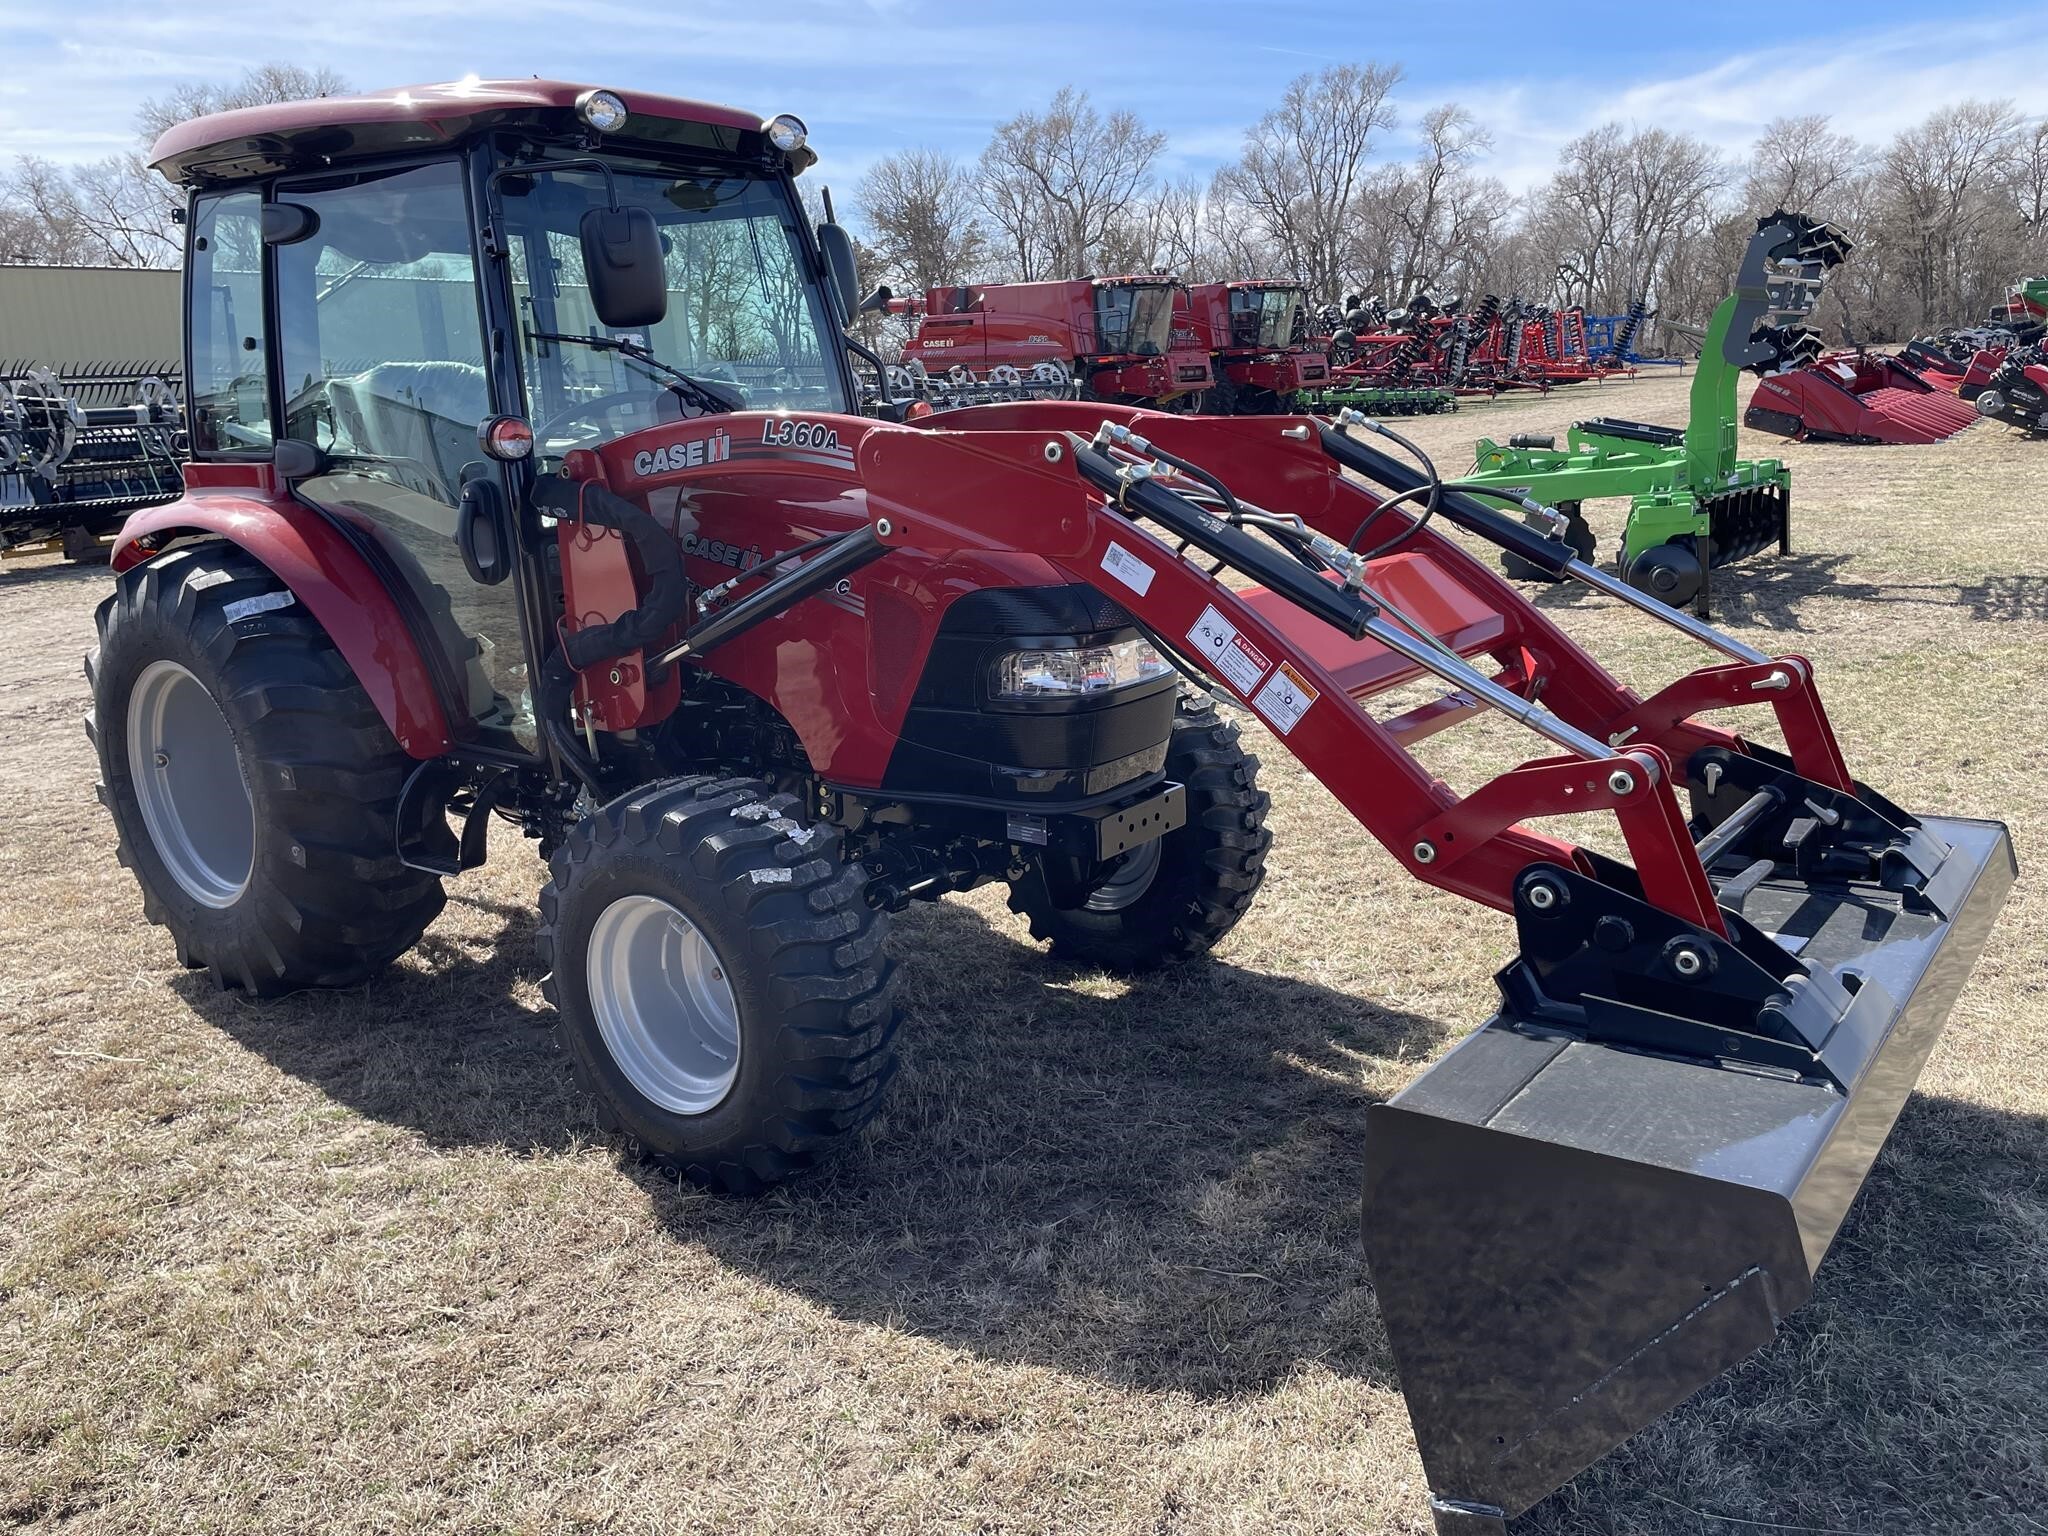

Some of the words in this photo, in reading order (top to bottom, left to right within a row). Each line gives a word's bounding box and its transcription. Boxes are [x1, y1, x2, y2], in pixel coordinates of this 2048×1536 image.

[923, 340, 945, 348] CASE
[762, 419, 839, 450] L360A
[634, 441, 703, 476] CASE
[682, 533, 739, 567] CASE
[1241, 643, 1267, 668] DANGER
[1290, 674, 1313, 696] WARNING
